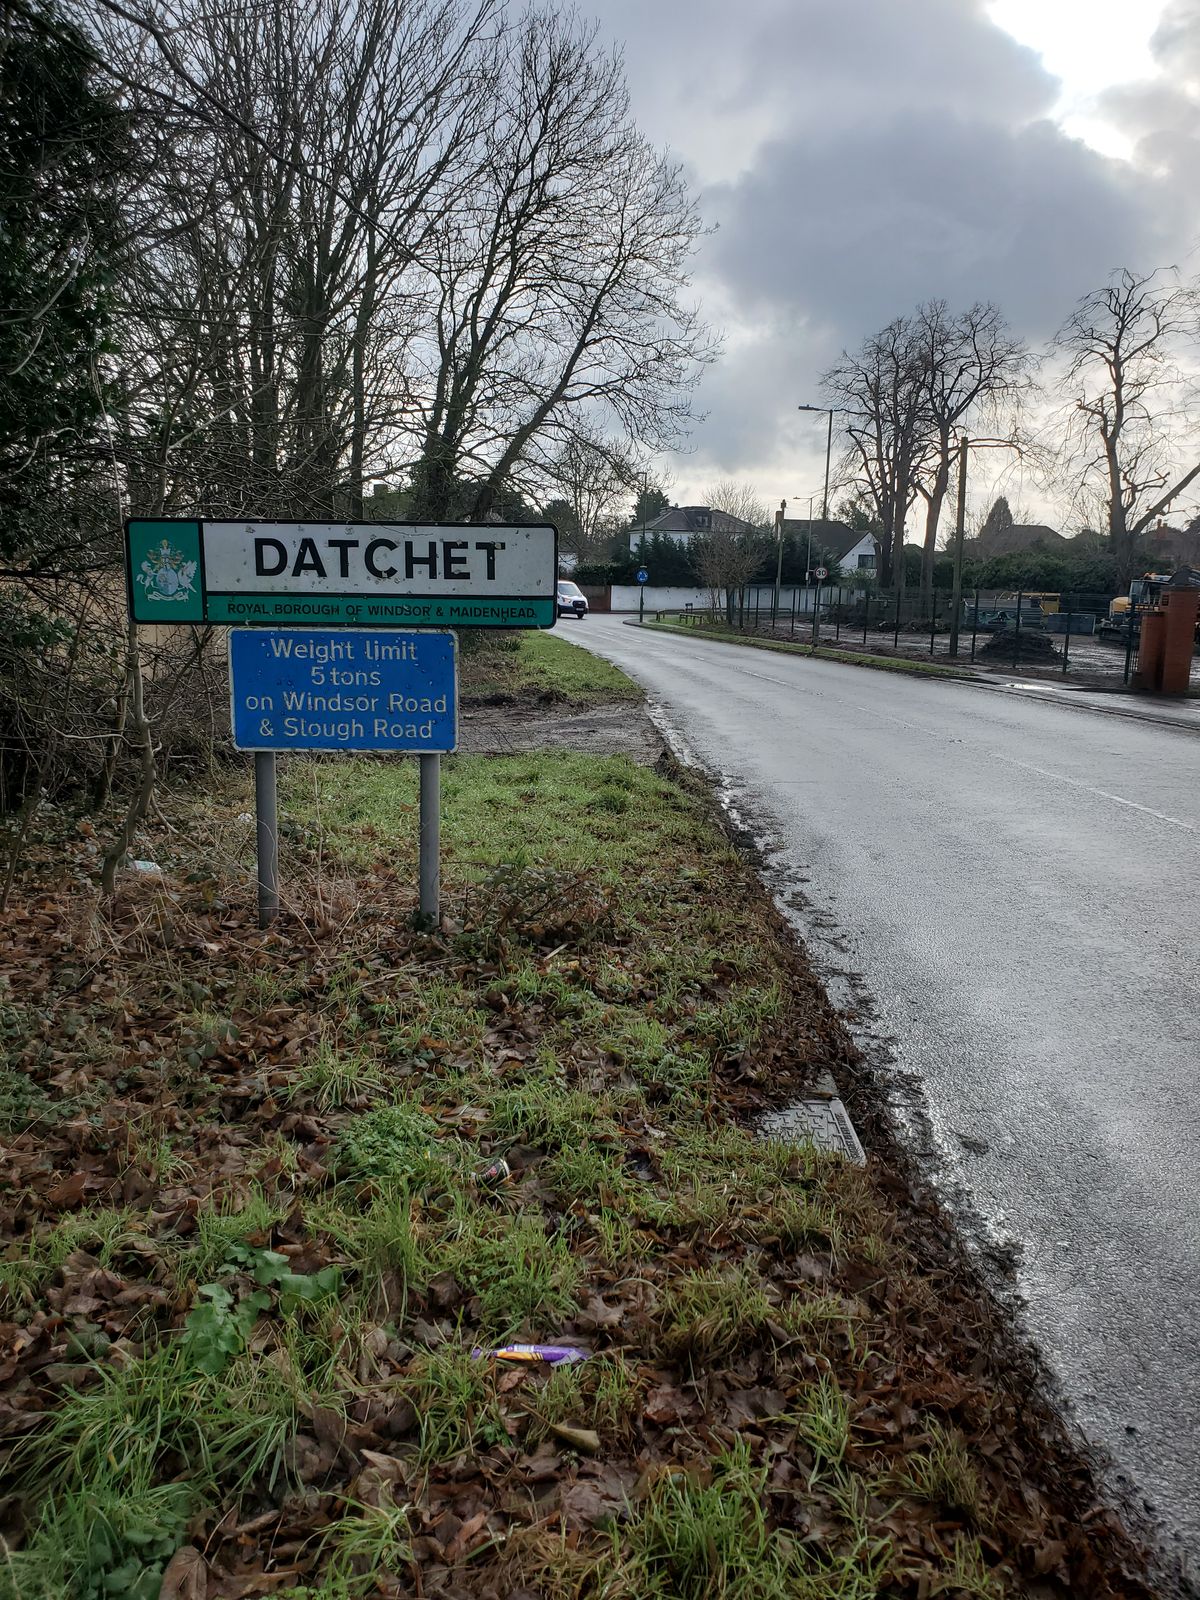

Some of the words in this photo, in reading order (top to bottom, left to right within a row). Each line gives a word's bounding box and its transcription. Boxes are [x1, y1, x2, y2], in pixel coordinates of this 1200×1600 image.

[254, 538, 506, 580] DATCHET
[227, 603, 269, 614] ROYAL
[274, 604, 340, 615] BOROUGH
[345, 605, 362, 615] OF
[368, 605, 431, 616] WINDSOR
[436, 607, 444, 617] &
[451, 607, 535, 618] MAIDENHEAD
[270, 638, 355, 663] Weight
[365, 640, 418, 660] limit
[311, 666, 325, 685] 5
[330, 667, 381, 686] tons
[246, 695, 273, 711] on
[283, 691, 379, 712] Windsor
[389, 693, 447, 713] Road
[259, 718, 274, 737] &
[284, 717, 364, 741] Slough
[374, 719, 434, 739] Road
